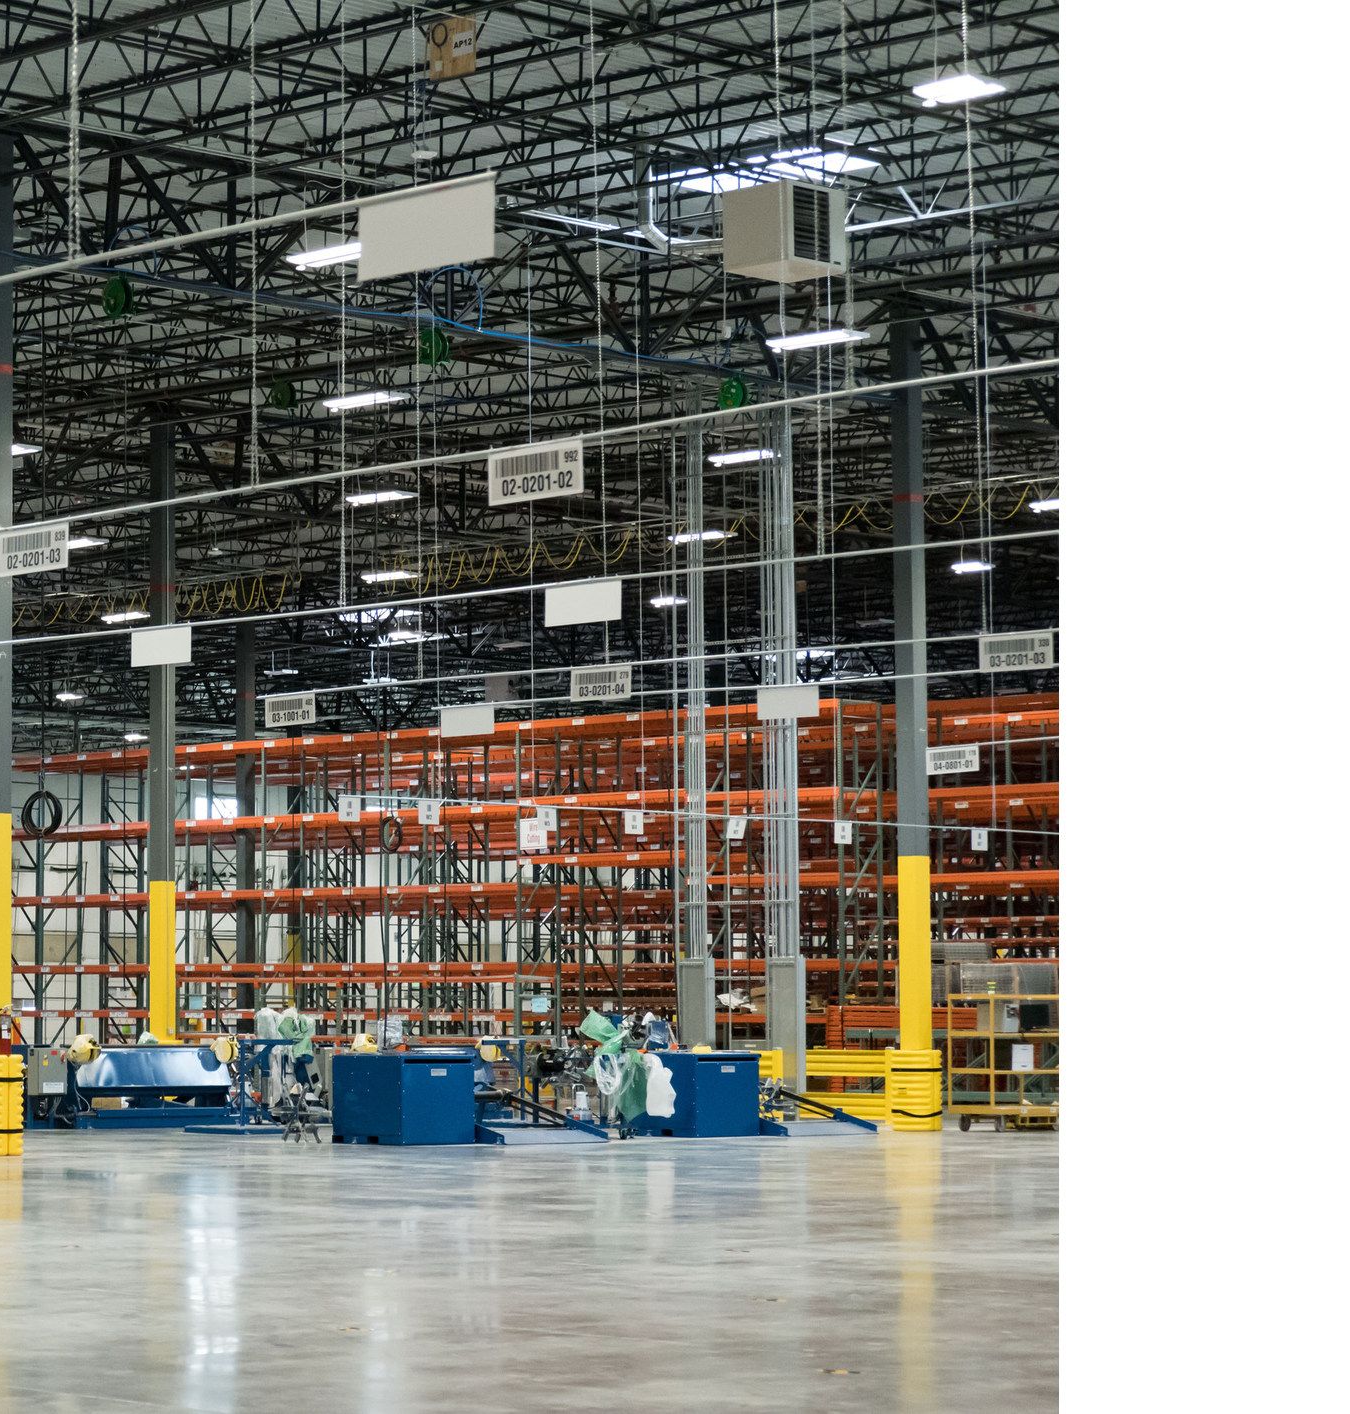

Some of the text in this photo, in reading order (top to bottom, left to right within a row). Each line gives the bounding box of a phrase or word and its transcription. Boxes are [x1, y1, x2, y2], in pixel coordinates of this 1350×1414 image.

[453, 37, 473, 49] AP12
[564, 449, 579, 463] 992
[501, 469, 574, 497] 02-0201-02
[54, 530, 66, 541] 839
[6, 547, 61, 570] 02-0201-03
[989, 651, 1046, 667] 03-0201-03
[578, 683, 625, 697] 03-0201-04
[271, 709, 310, 723] 03-1001-01
[933, 759, 973, 771] 04-0801-01
